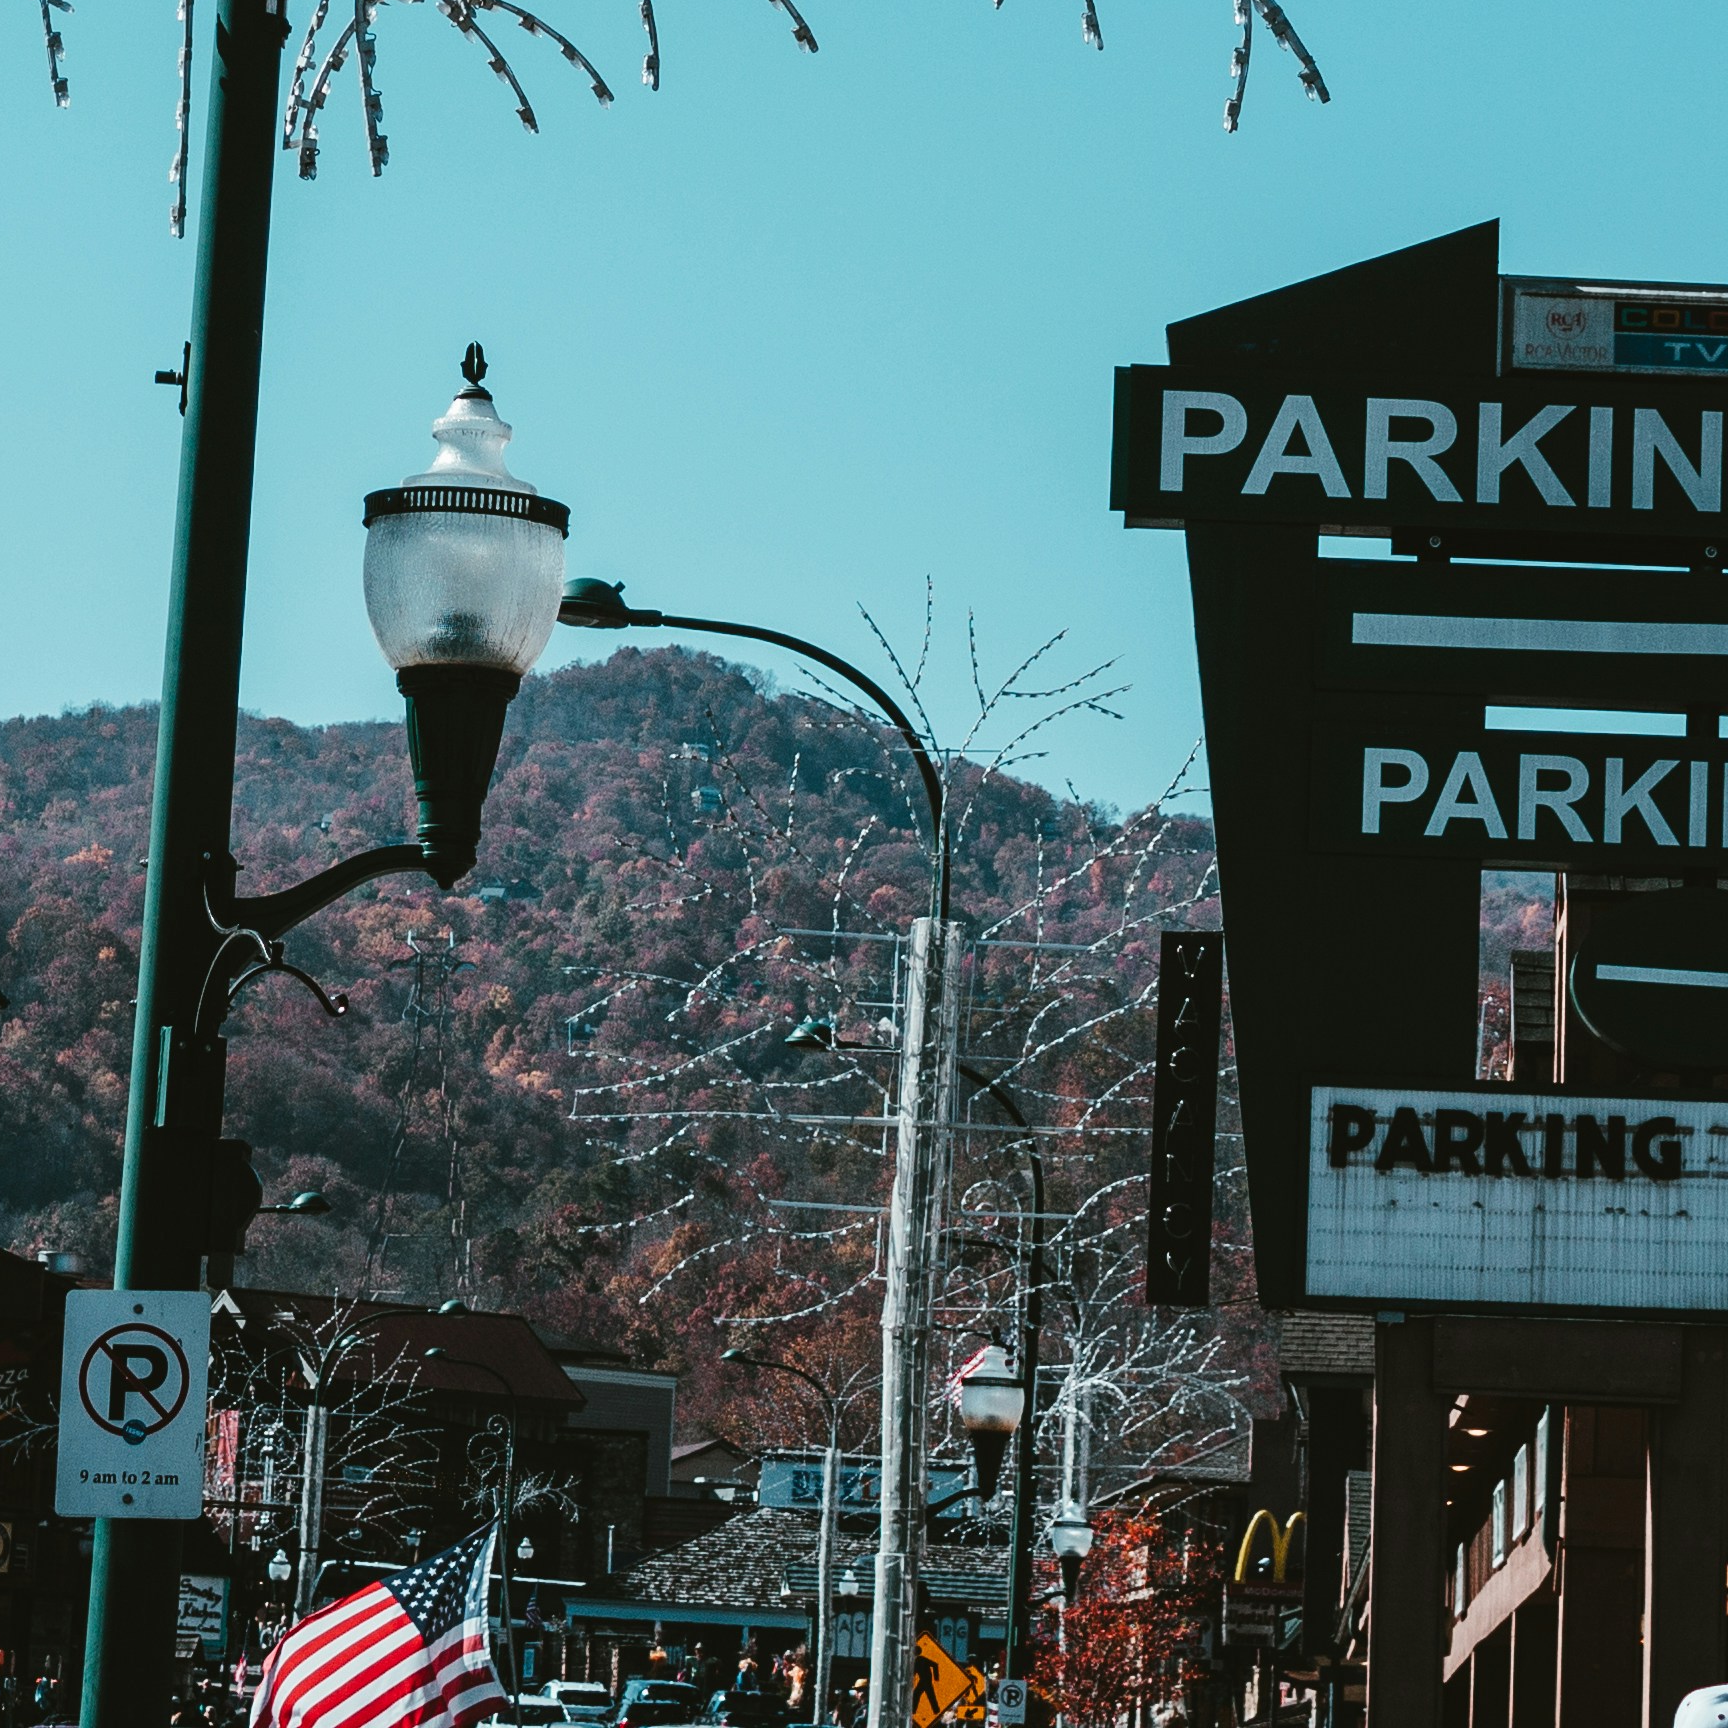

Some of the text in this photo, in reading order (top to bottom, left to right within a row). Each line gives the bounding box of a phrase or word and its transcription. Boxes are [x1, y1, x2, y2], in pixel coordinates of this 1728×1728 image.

[1663, 341, 1728, 363] TV
[1330, 1103, 1684, 1181] PARKING
[79, 1469, 180, 1486] 9 am to 2 am
